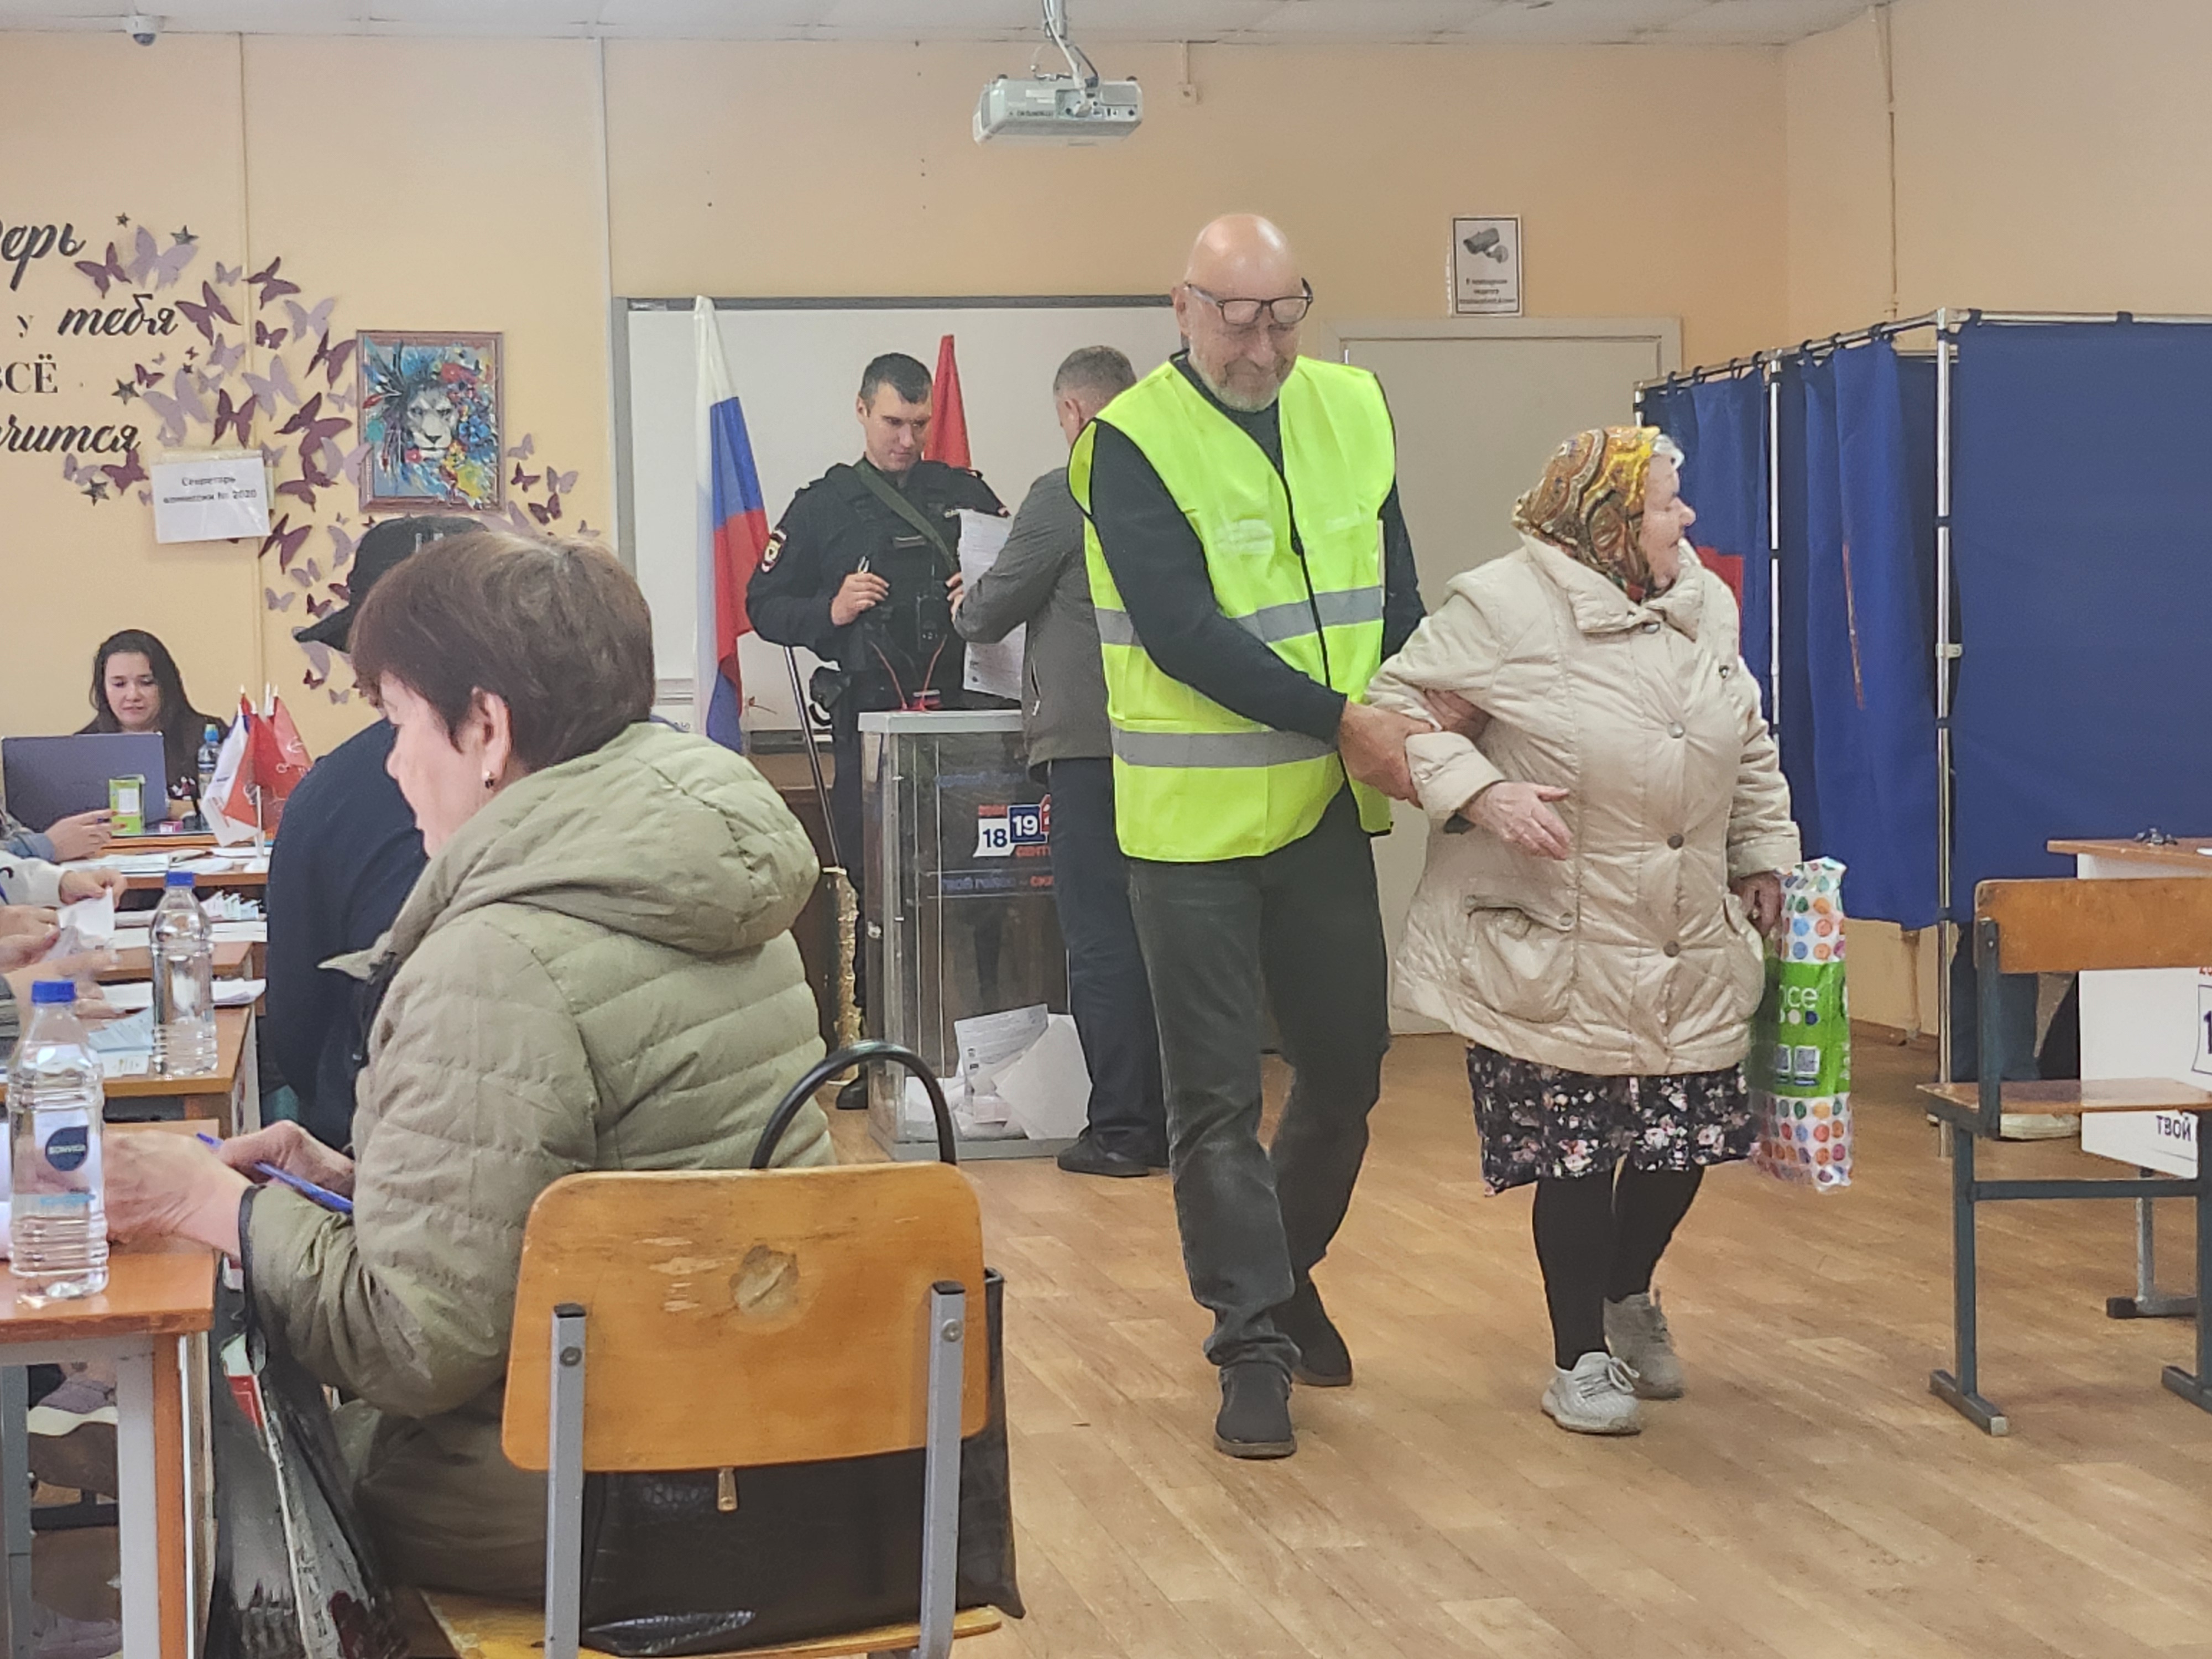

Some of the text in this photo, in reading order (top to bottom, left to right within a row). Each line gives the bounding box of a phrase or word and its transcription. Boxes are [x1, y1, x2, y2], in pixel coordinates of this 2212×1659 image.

[0, 222, 86, 291] ерь
[57, 293, 179, 336] тебя
[0, 354, 58, 394] СЁ
[0, 414, 142, 453] чится
[983, 828, 1008, 848] 18
[1013, 815, 1038, 837] 19
[2156, 1114, 2192, 1142] ТВОЙ
